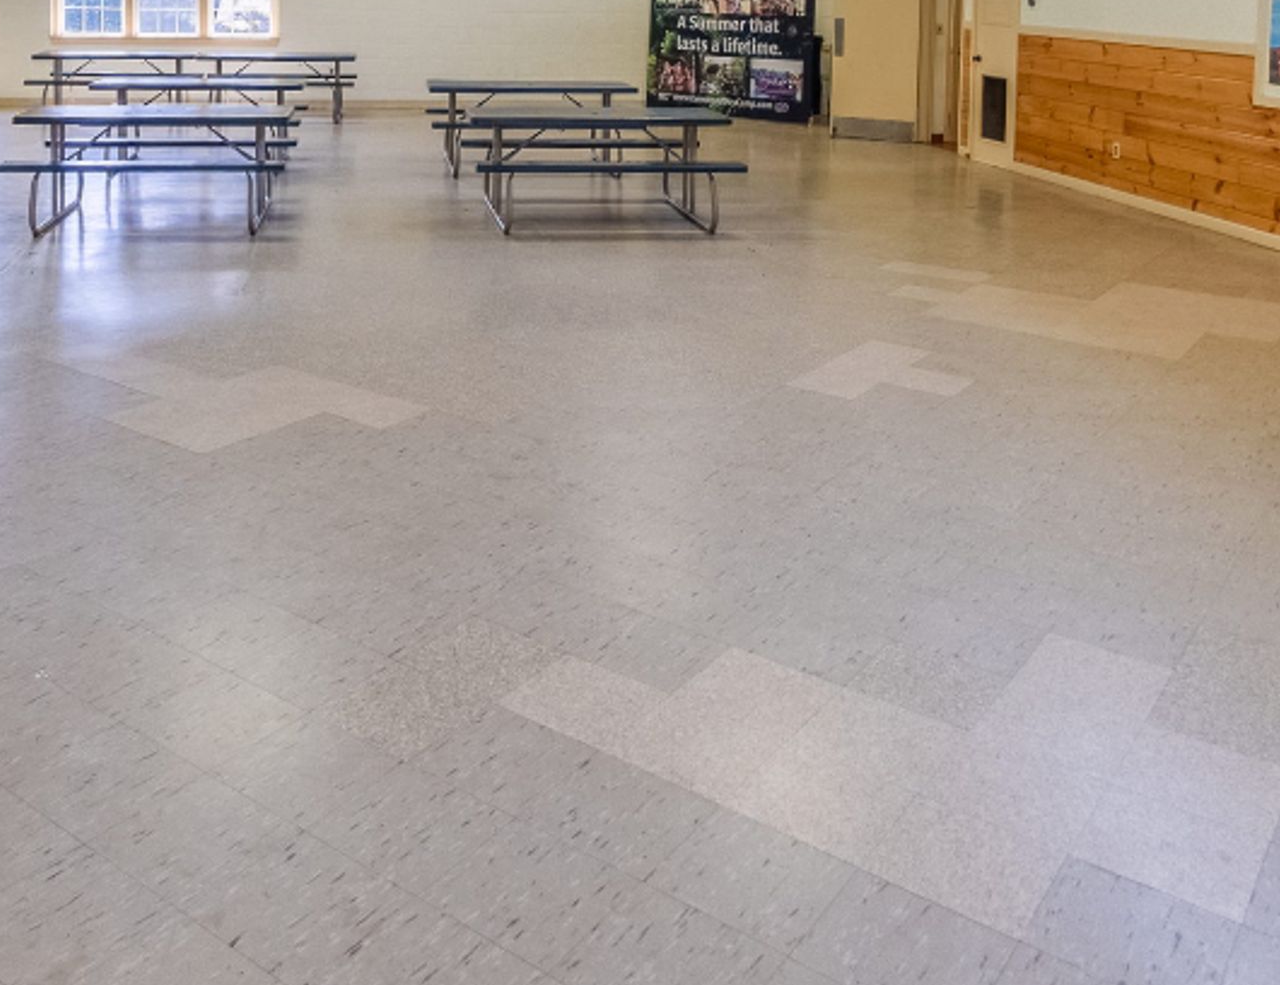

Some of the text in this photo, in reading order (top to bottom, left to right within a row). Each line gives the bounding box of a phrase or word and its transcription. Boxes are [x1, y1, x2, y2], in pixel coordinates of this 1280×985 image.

[677, 15, 781, 34] A Summer that
[677, 35, 783, 56] lasts a lifetime.
